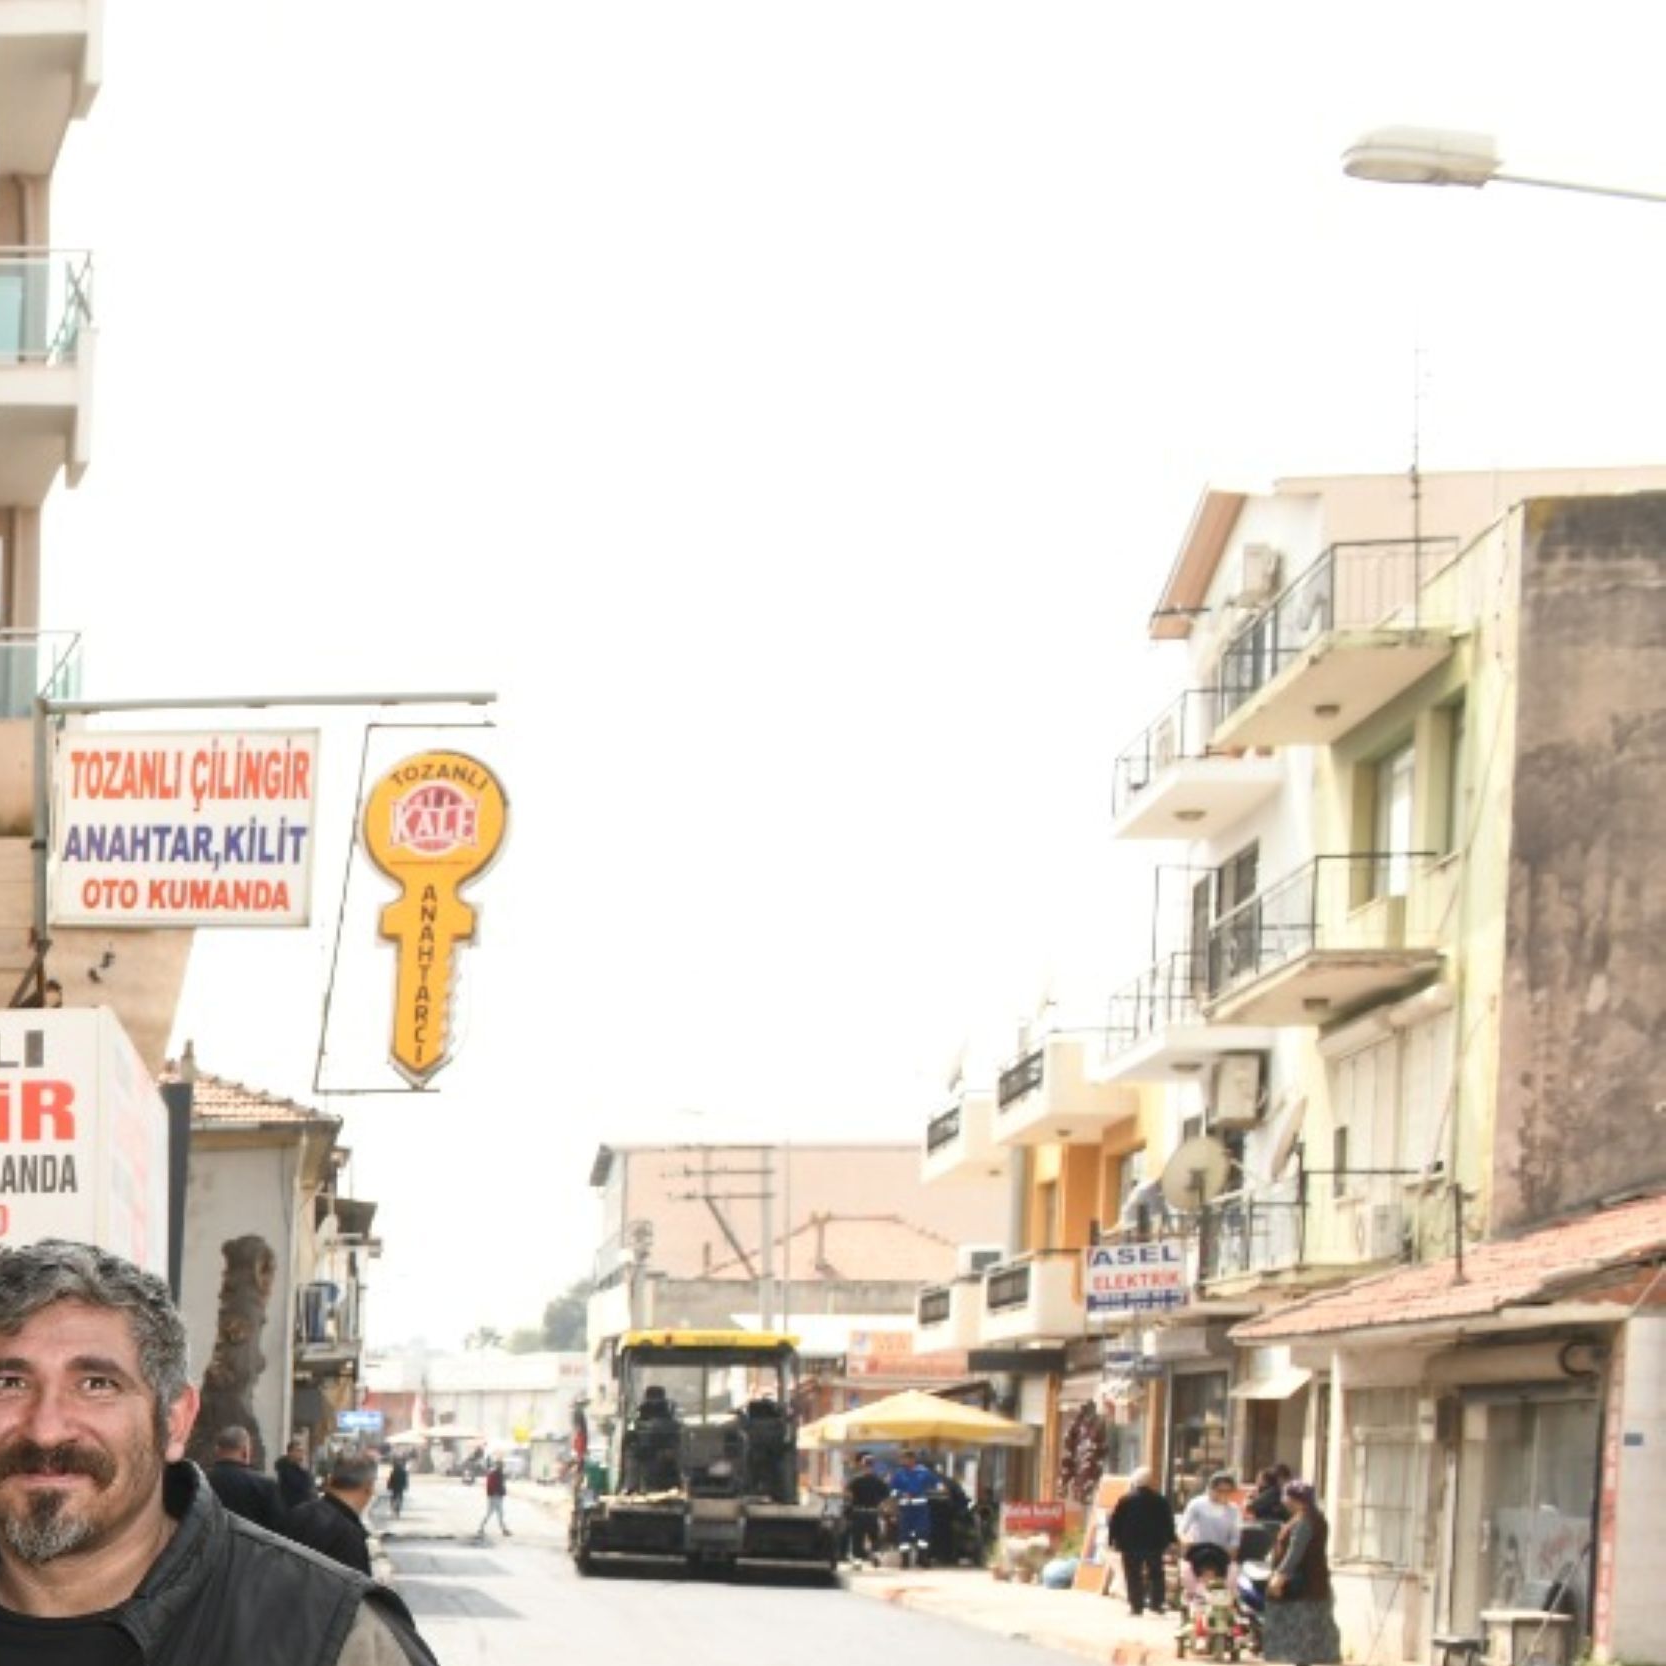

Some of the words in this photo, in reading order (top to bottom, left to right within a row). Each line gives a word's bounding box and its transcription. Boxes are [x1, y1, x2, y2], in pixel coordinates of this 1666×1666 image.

[71, 749, 186, 800] TOZANLI
[193, 736, 310, 811] ÇİLİNGİR
[389, 763, 489, 790] TOZANLI
[390, 801, 478, 847] KALE
[82, 878, 134, 910] OTO
[147, 879, 290, 913] KUMANDA
[413, 884, 438, 1063] ANAHTARCI
[1093, 1246, 1180, 1265] ASEL
